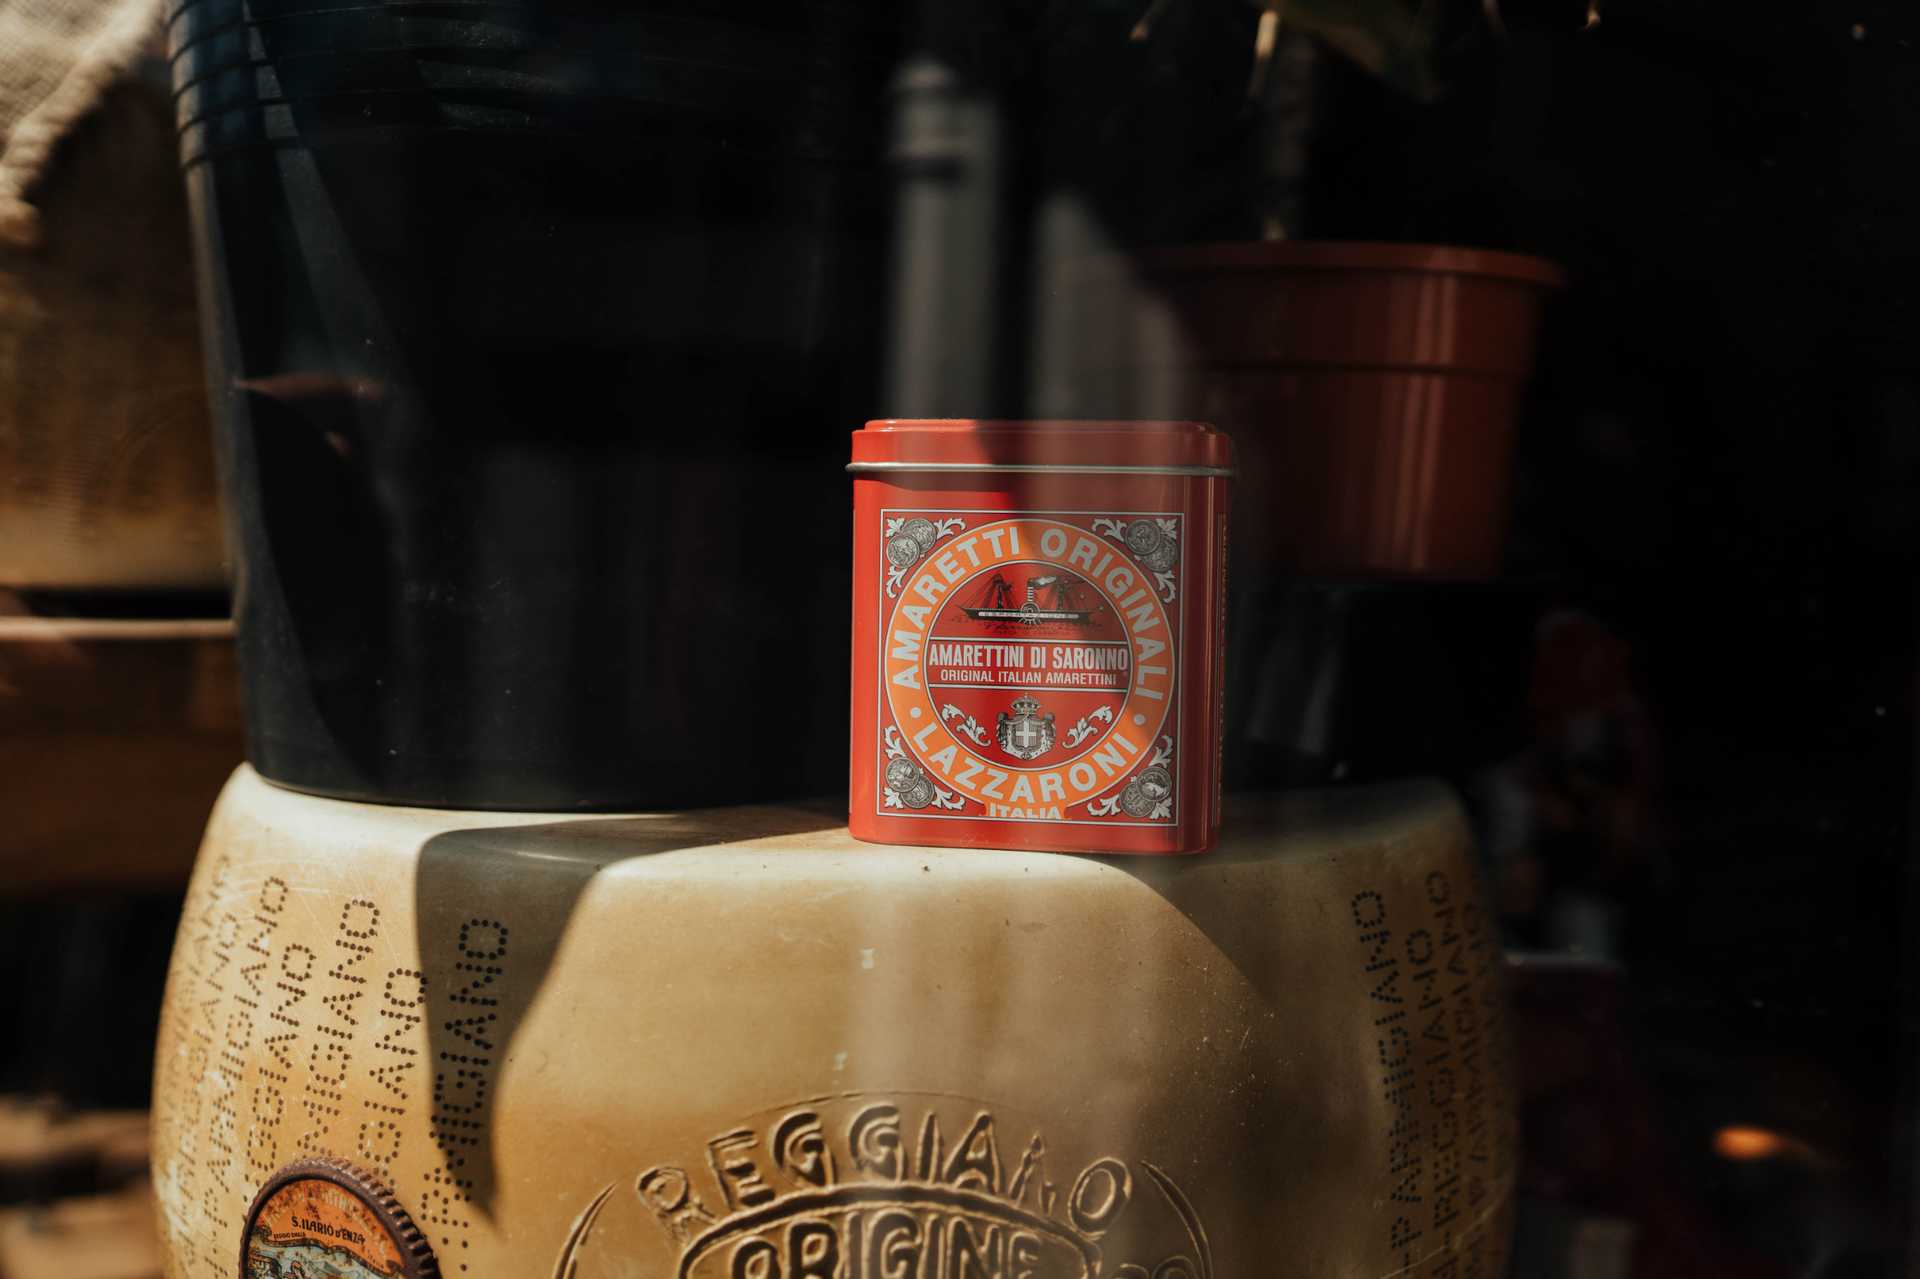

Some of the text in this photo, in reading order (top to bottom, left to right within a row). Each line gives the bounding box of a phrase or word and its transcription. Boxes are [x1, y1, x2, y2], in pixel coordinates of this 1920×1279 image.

[892, 526, 1169, 701] AMARETTI ORIGINALI
[929, 643, 1129, 671] AMARETTINI DI SARONNO
[940, 669, 1117, 686] ORIGINAL ITALIAN AMARETTINI
[912, 721, 1138, 803] LAZZARONI
[989, 803, 1062, 819] ITALIA
[202, 876, 289, 1228] PARMIGIANO
[242, 943, 318, 1218] GGIANO
[297, 899, 381, 1160] MIGIANO
[358, 966, 429, 1184] GIANO
[420, 917, 510, 1271] RMIGIANO
